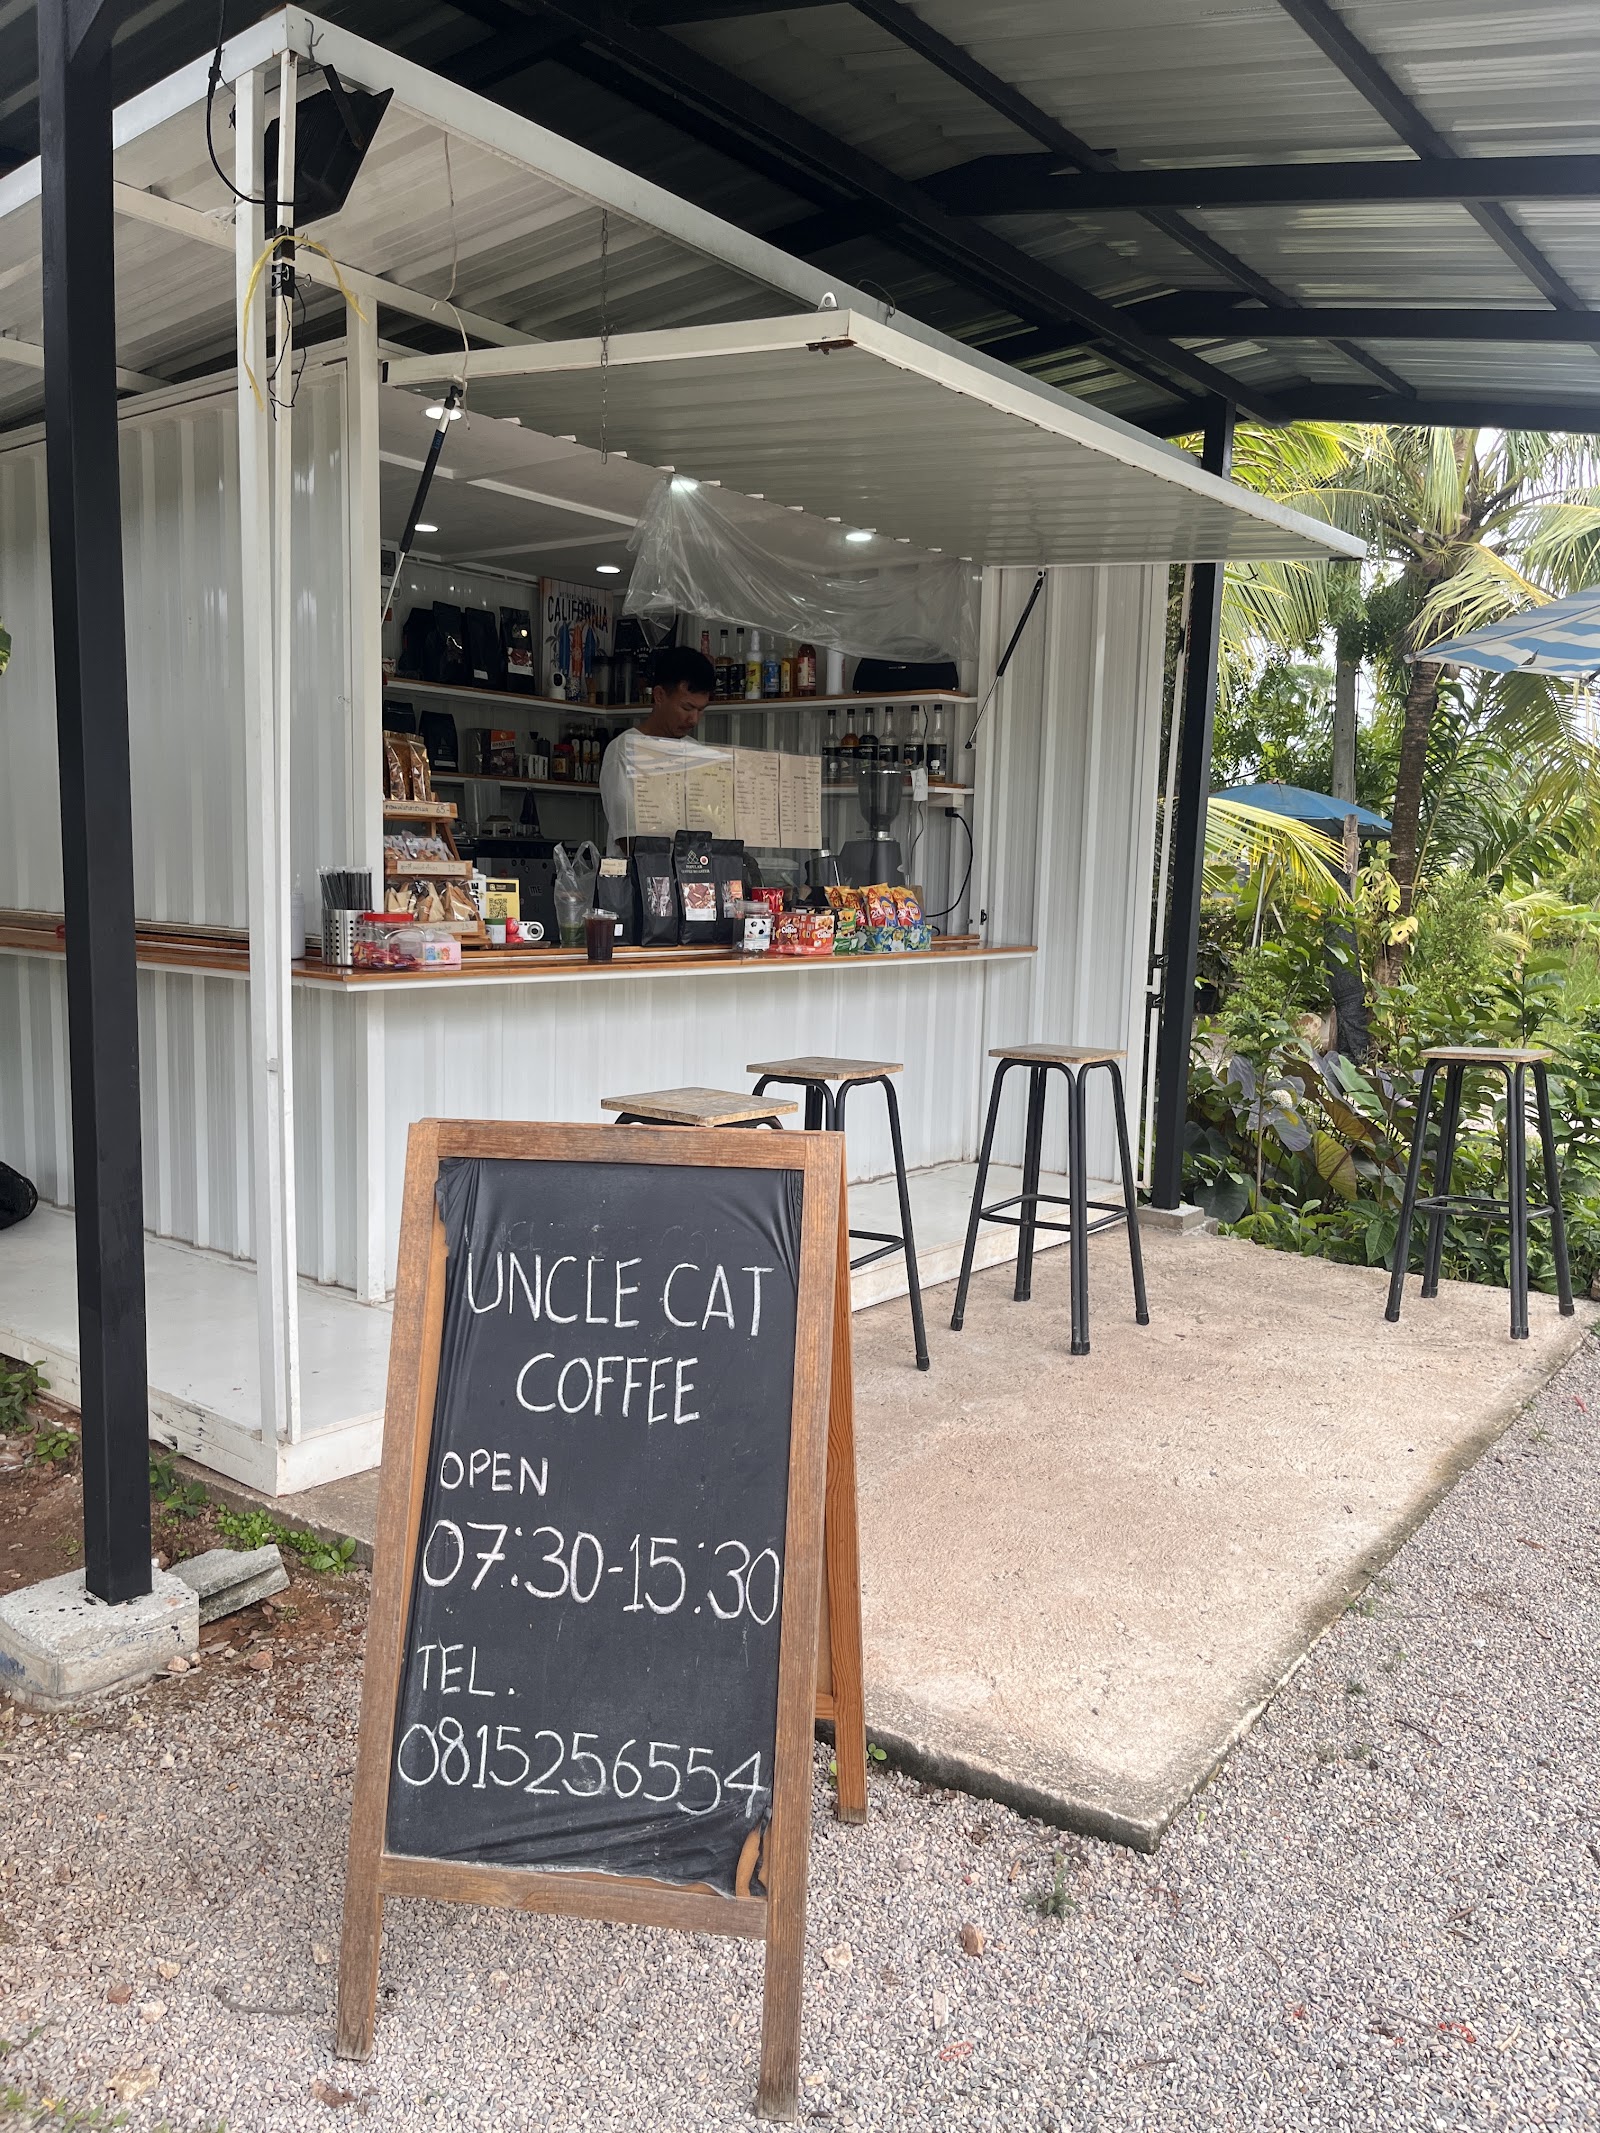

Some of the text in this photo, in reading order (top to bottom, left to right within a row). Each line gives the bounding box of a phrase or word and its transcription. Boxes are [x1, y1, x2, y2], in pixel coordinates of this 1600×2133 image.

[547, 596, 609, 634] CALIFORNIA
[467, 1252, 775, 1336] UNCLE CAT
[516, 1352, 700, 1424] COFFEE
[440, 1449, 549, 1496] OPEN
[422, 1519, 780, 1626] 07:30-15:30
[417, 1643, 516, 1697] TEL.
[397, 1716, 771, 1819] 0815256554
